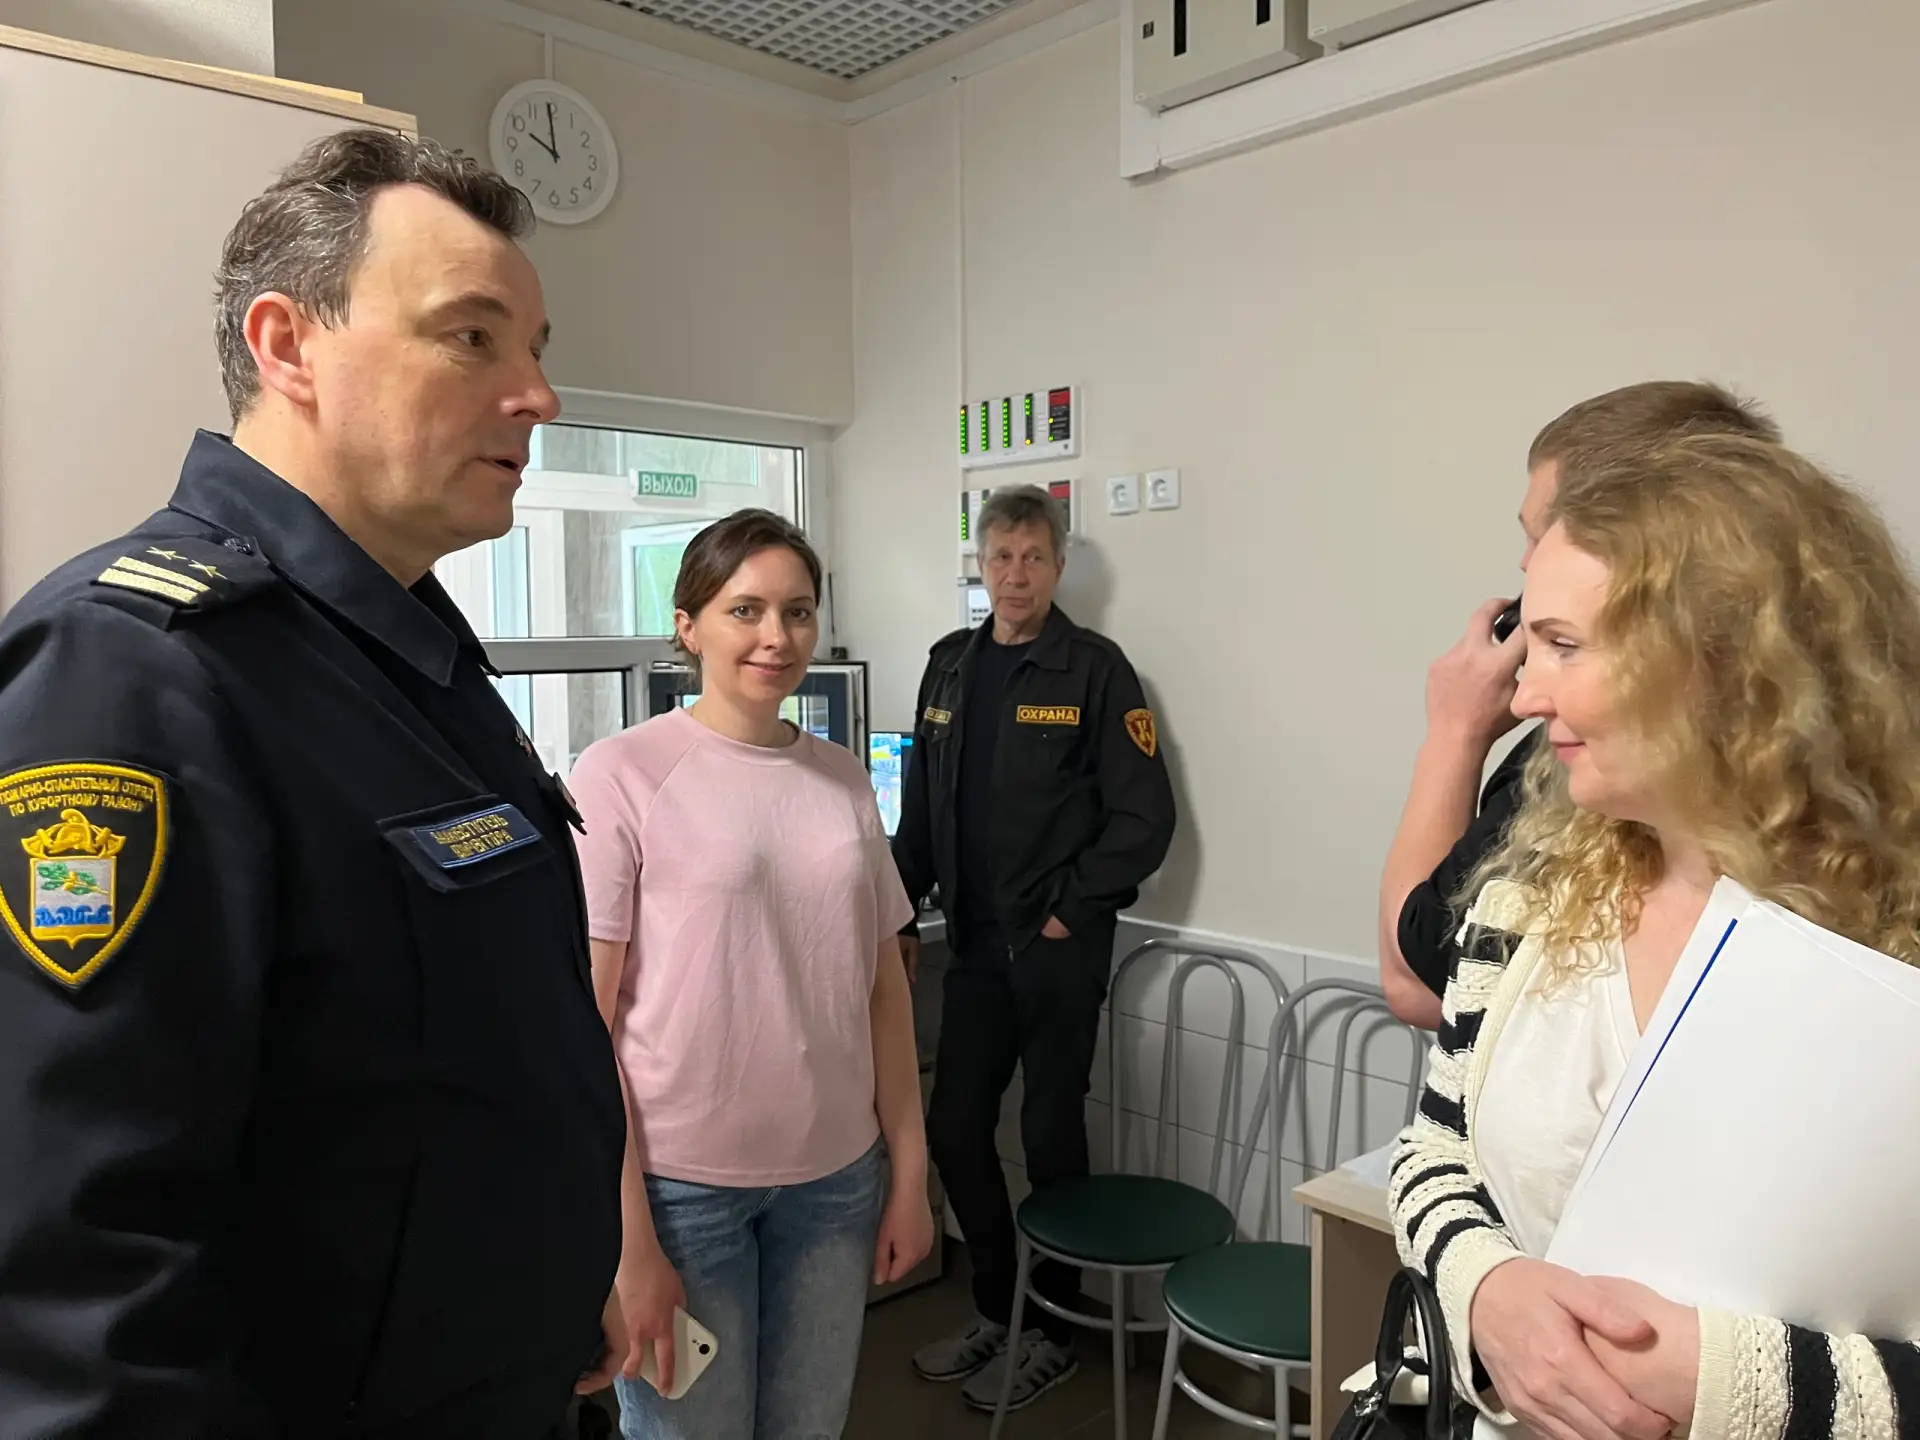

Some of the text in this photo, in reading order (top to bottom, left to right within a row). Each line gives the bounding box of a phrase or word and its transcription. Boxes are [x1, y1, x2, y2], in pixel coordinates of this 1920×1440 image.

[506, 136, 518, 153] 9
[580, 131, 590, 149] 2
[514, 159, 525, 177] 8
[588, 154, 598, 171] 3
[531, 178, 542, 194] 7
[582, 176, 593, 191] 4
[548, 190, 560, 206] 6
[569, 187, 578, 204] 5
[641, 473, 694, 496] ВЫХОД
[1020, 708, 1075, 721] ОХРАНА
[9, 802, 25, 817] ПО
